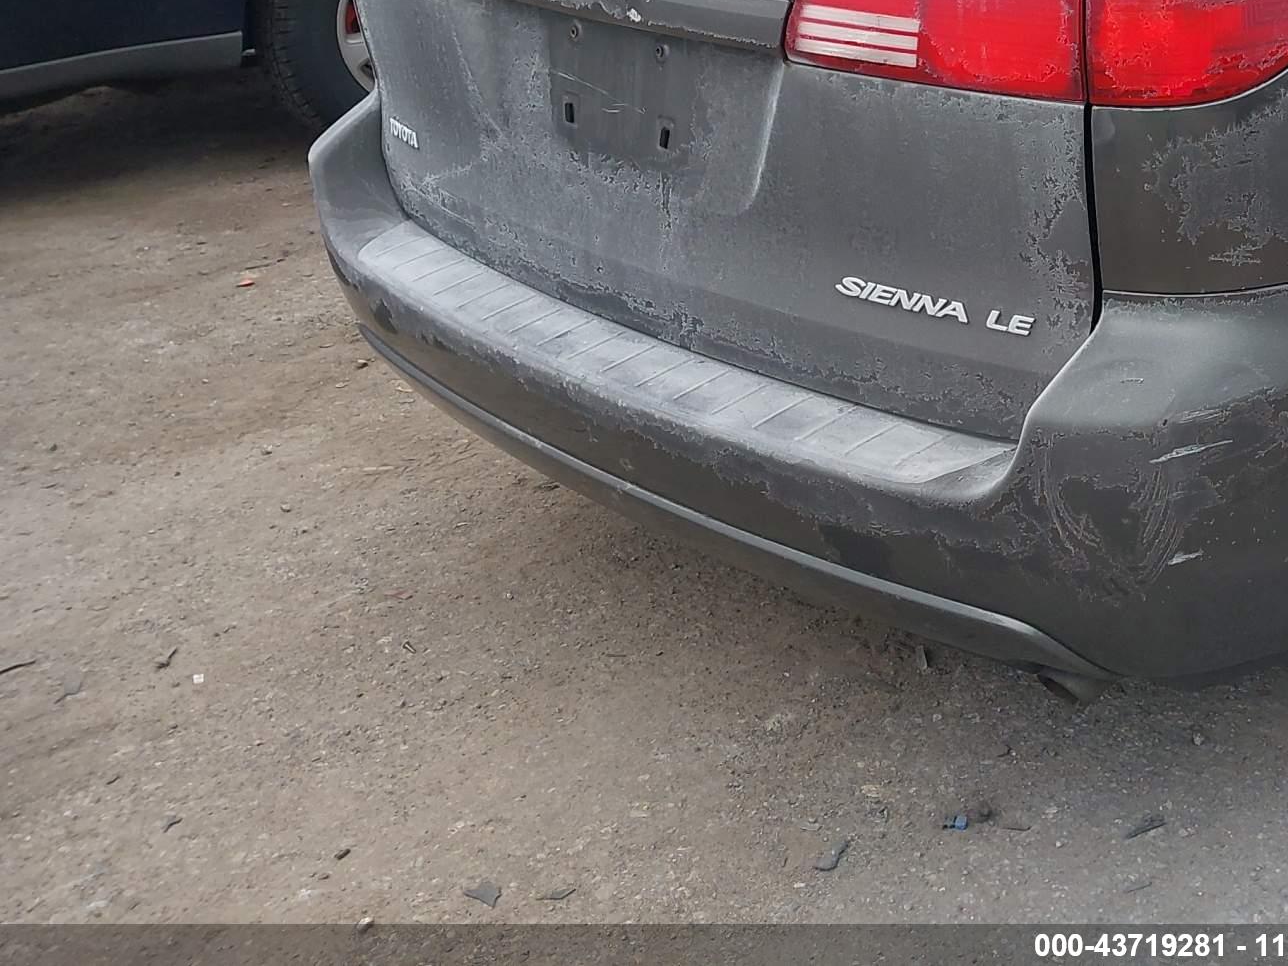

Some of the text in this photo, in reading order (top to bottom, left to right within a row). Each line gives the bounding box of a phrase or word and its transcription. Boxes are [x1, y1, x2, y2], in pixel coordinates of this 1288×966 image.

[389, 117, 419, 149] TOYOTA
[834, 276, 1036, 337] SIENNA LE
